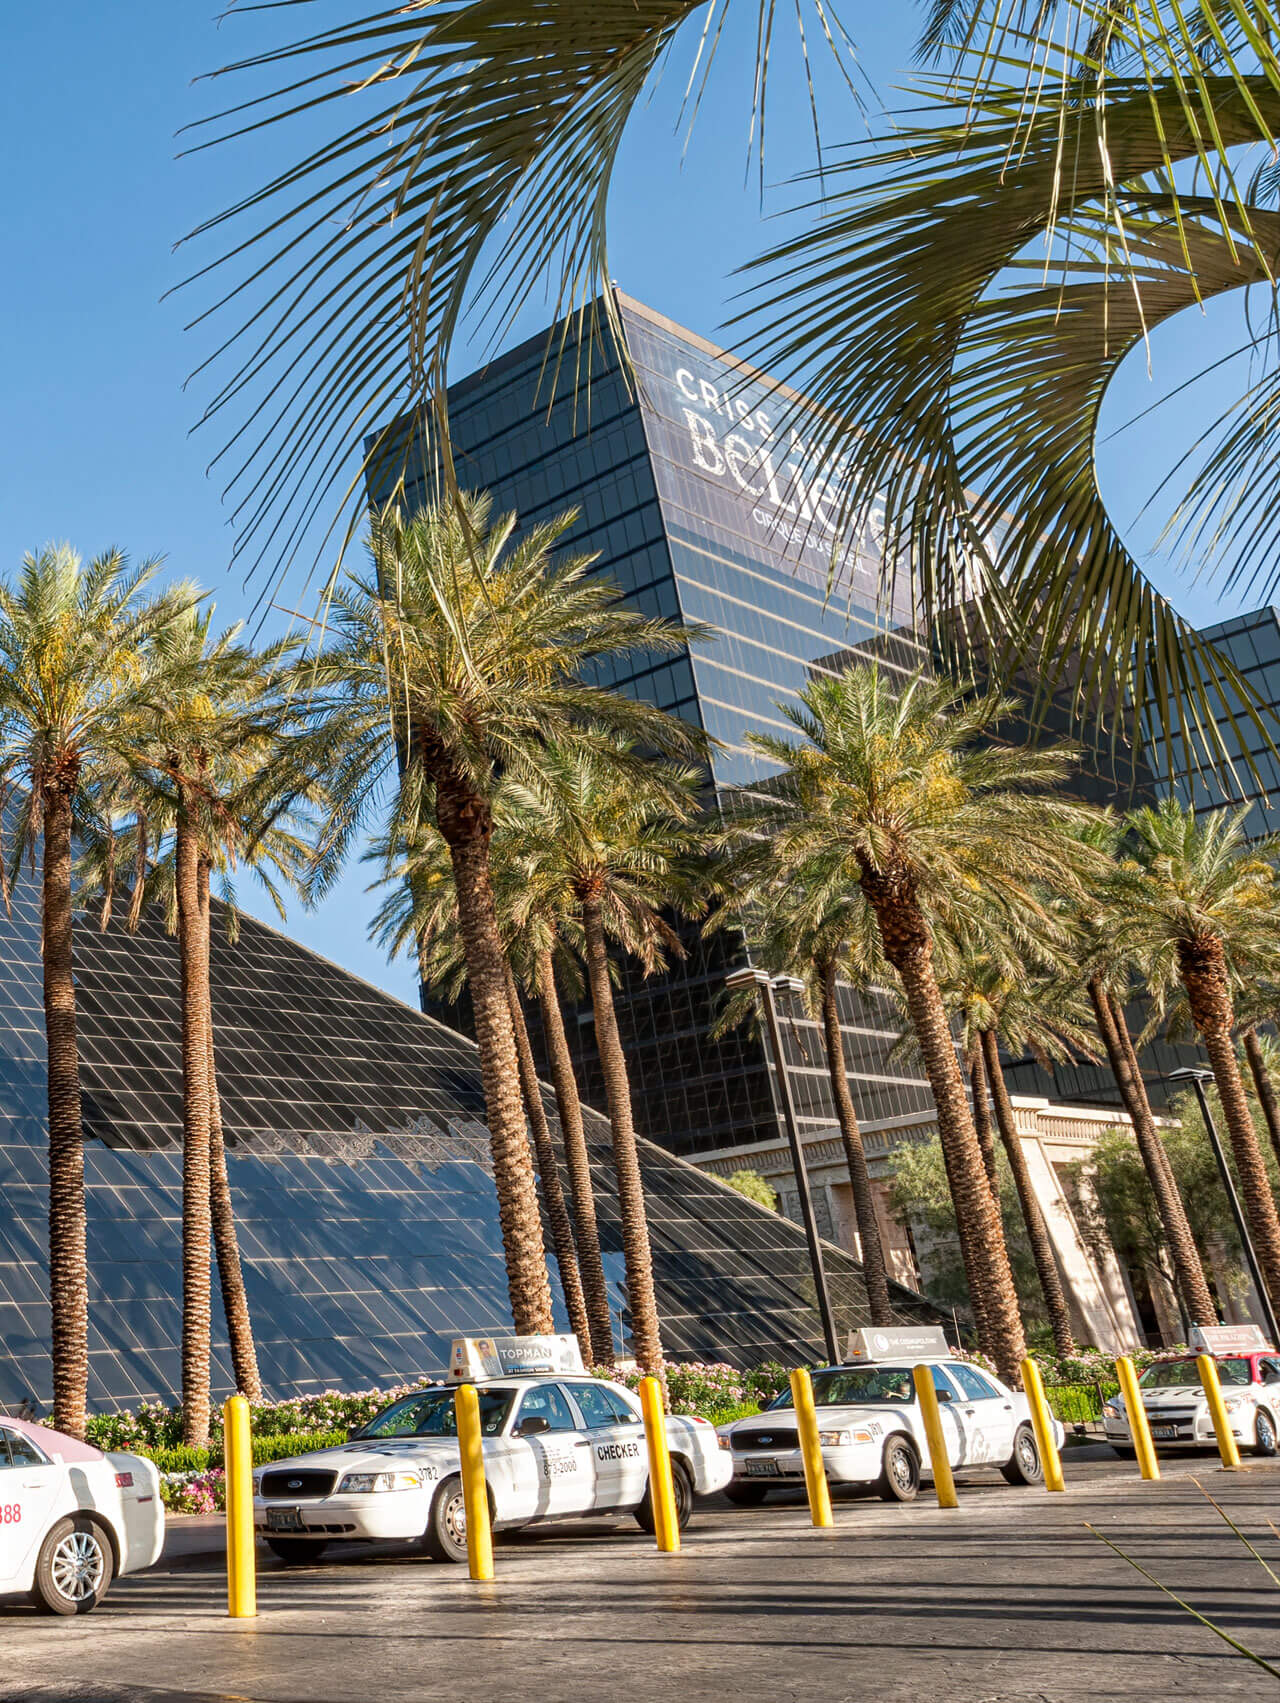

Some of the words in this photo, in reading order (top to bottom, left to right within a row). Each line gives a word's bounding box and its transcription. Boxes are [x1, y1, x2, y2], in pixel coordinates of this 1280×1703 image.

[676, 368, 775, 442] CRISS
[500, 1348, 552, 1361] TOPMAN
[597, 1443, 640, 1461] CHECKER
